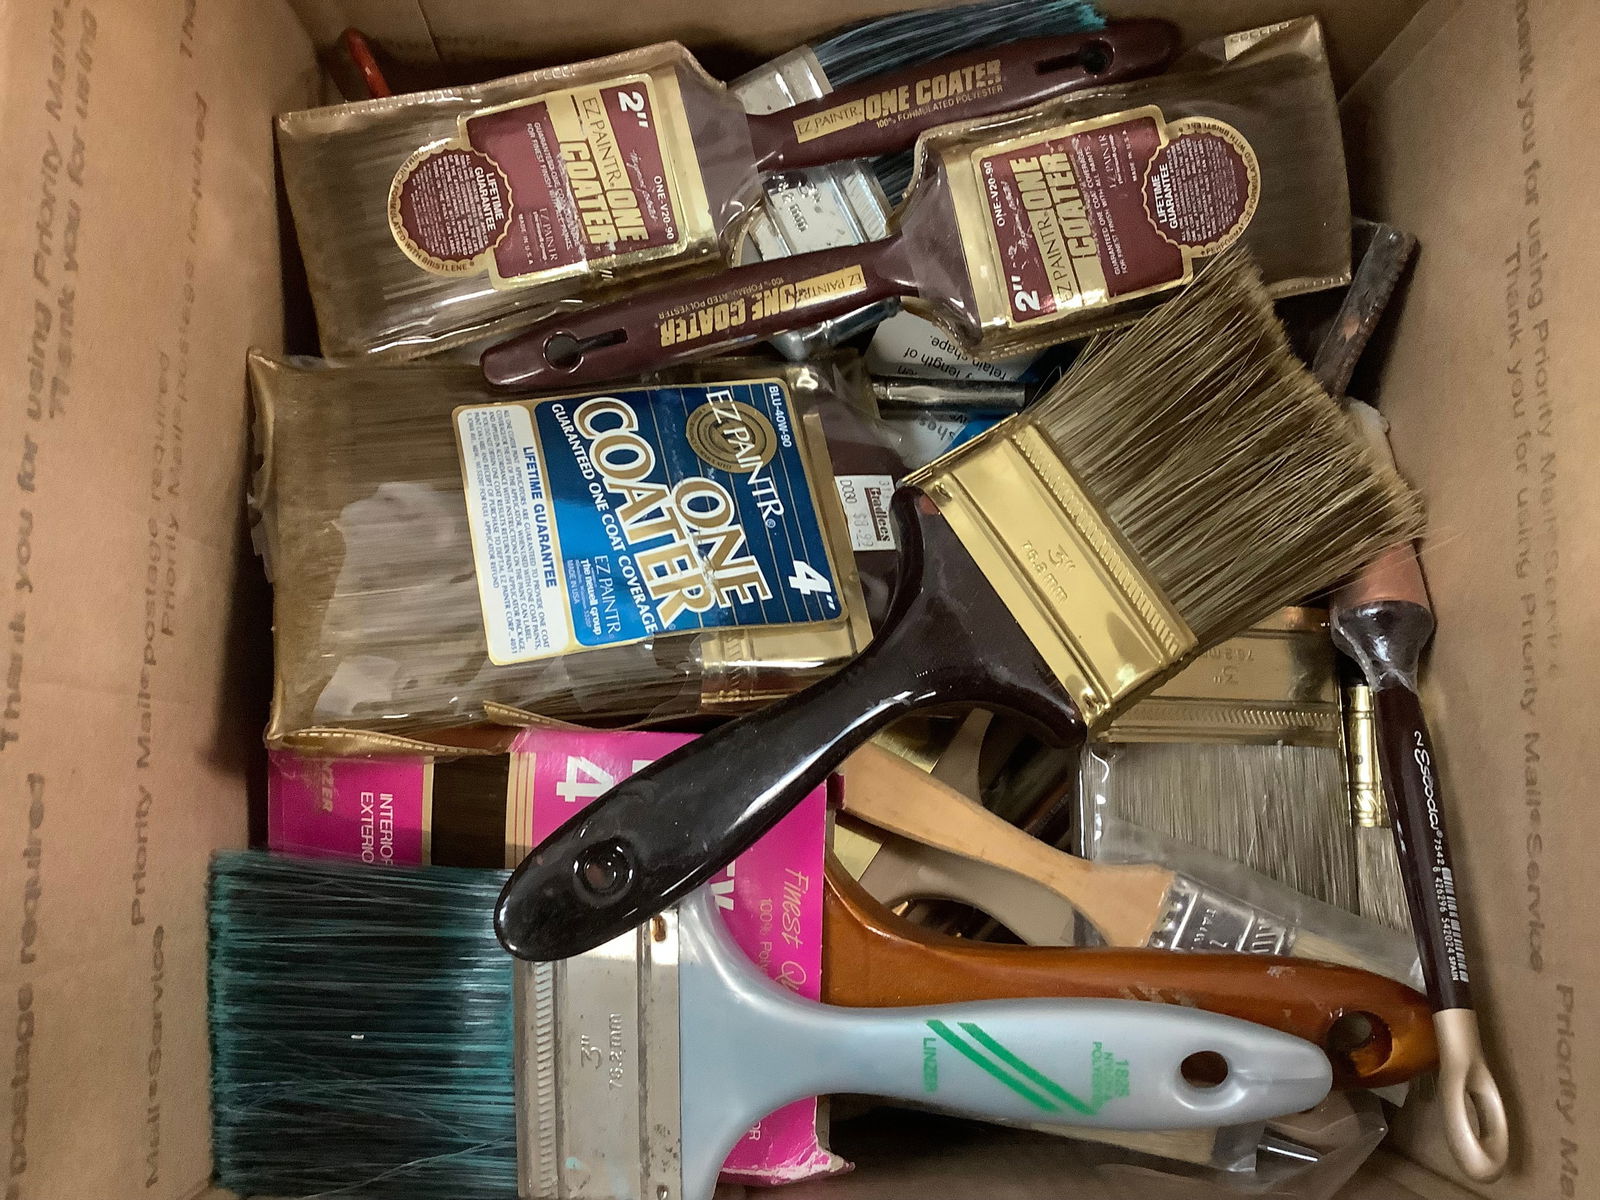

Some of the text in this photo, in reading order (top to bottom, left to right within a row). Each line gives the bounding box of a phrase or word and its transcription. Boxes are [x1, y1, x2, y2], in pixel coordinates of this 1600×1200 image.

[581, 96, 601, 120] EZ
[616, 87, 649, 132] 2"
[862, 84, 914, 120] ONE
[910, 56, 1006, 107] COATER
[1516, 87, 1535, 155] you
[66, 123, 85, 188] for
[474, 166, 496, 231] GUARANTEE
[485, 171, 504, 220] LIFETIME
[558, 140, 618, 245] COATER
[983, 160, 1006, 227] ONE-V20-90
[1009, 156, 1053, 211] ONE
[1039, 151, 1098, 257] COATER
[1151, 174, 1167, 222] LIFETIME
[1159, 163, 1178, 229] GUARANTEE
[1523, 158, 1541, 206] for
[32, 128, 62, 287] Priority
[603, 188, 648, 242] ONE
[652, 175, 675, 241] ONE-V20-90
[1096, 210, 1121, 274] GUARANTEED ONE
[1103, 208, 1128, 273] FOR FINEST FINISH
[1526, 216, 1549, 310] using
[744, 282, 799, 321] ONE
[846, 272, 862, 286] EZ
[1009, 270, 1041, 314] 2"
[1504, 241, 1523, 350] Thank
[654, 297, 750, 347] COATER
[657, 298, 705, 319] POLYESTER
[26, 297, 51, 421] using
[903, 346, 918, 359] of
[919, 352, 959, 377] length
[1507, 357, 1526, 419] you
[1532, 318, 1555, 438] Priority
[704, 389, 741, 424] EZ
[768, 384, 791, 448] BLU-40W-90
[16, 435, 38, 493] for
[495, 447, 507, 485] ACCORDANCE
[1515, 431, 1531, 477] for
[493, 480, 501, 497] COAT
[502, 486, 510, 504] WITH
[514, 466, 526, 505] APPLICATORS
[496, 499, 506, 526] RESULTS
[505, 506, 519, 554] INSTRUCTIONS
[522, 446, 557, 588] LIFETIME GUARANTEE
[551, 403, 659, 634] GUARANTEED ONE COAT COVERAGE
[572, 397, 715, 630] COATER
[1515, 486, 1534, 580] using
[15, 507, 33, 593] you
[483, 520, 495, 559] APPLICATOR
[489, 561, 500, 588] REFUND
[483, 464, 517, 654] RECEIPT OF PURCHASE TO EZ PAINTR 4051
[500, 527, 510, 554] RETURN
[513, 555, 520, 566] ON
[517, 529, 526, 551] WHEN
[520, 551, 528, 567] USED
[524, 521, 536, 566] GUARANTEED
[671, 476, 774, 611] ONE
[160, 511, 181, 636] Priority
[505, 555, 513, 573] PAINT
[523, 569, 531, 587] WITH
[531, 568, 538, 576] TO
[566, 559, 575, 578] MADE
[571, 588, 580, 604] USA
[580, 558, 590, 575] The
[594, 554, 610, 575] EZ
[787, 560, 836, 611] 4"
[508, 575, 519, 616] APPLICATOR
[517, 582, 526, 601] PAINT
[520, 602, 528, 618] CAN
[526, 587, 534, 602] ONE
[528, 603, 537, 622] COAT
[532, 579, 543, 609] PROVIDE
[584, 574, 598, 605] newell
[538, 611, 546, 626] ONE
[540, 629, 549, 648] COAT
[589, 606, 602, 635] group
[1519, 592, 1541, 717] Priority
[360, 791, 374, 863] EXTERIO
[130, 784, 151, 926] Priority
[1431, 838, 1445, 866] 7542
[758, 897, 773, 936] 100%
[780, 868, 809, 949] Finest
[1432, 876, 1448, 913] 426296
[1439, 916, 1455, 955] 542024
[1447, 954, 1459, 981] SPAIN
[1554, 982, 1580, 1200] Priority Ma
